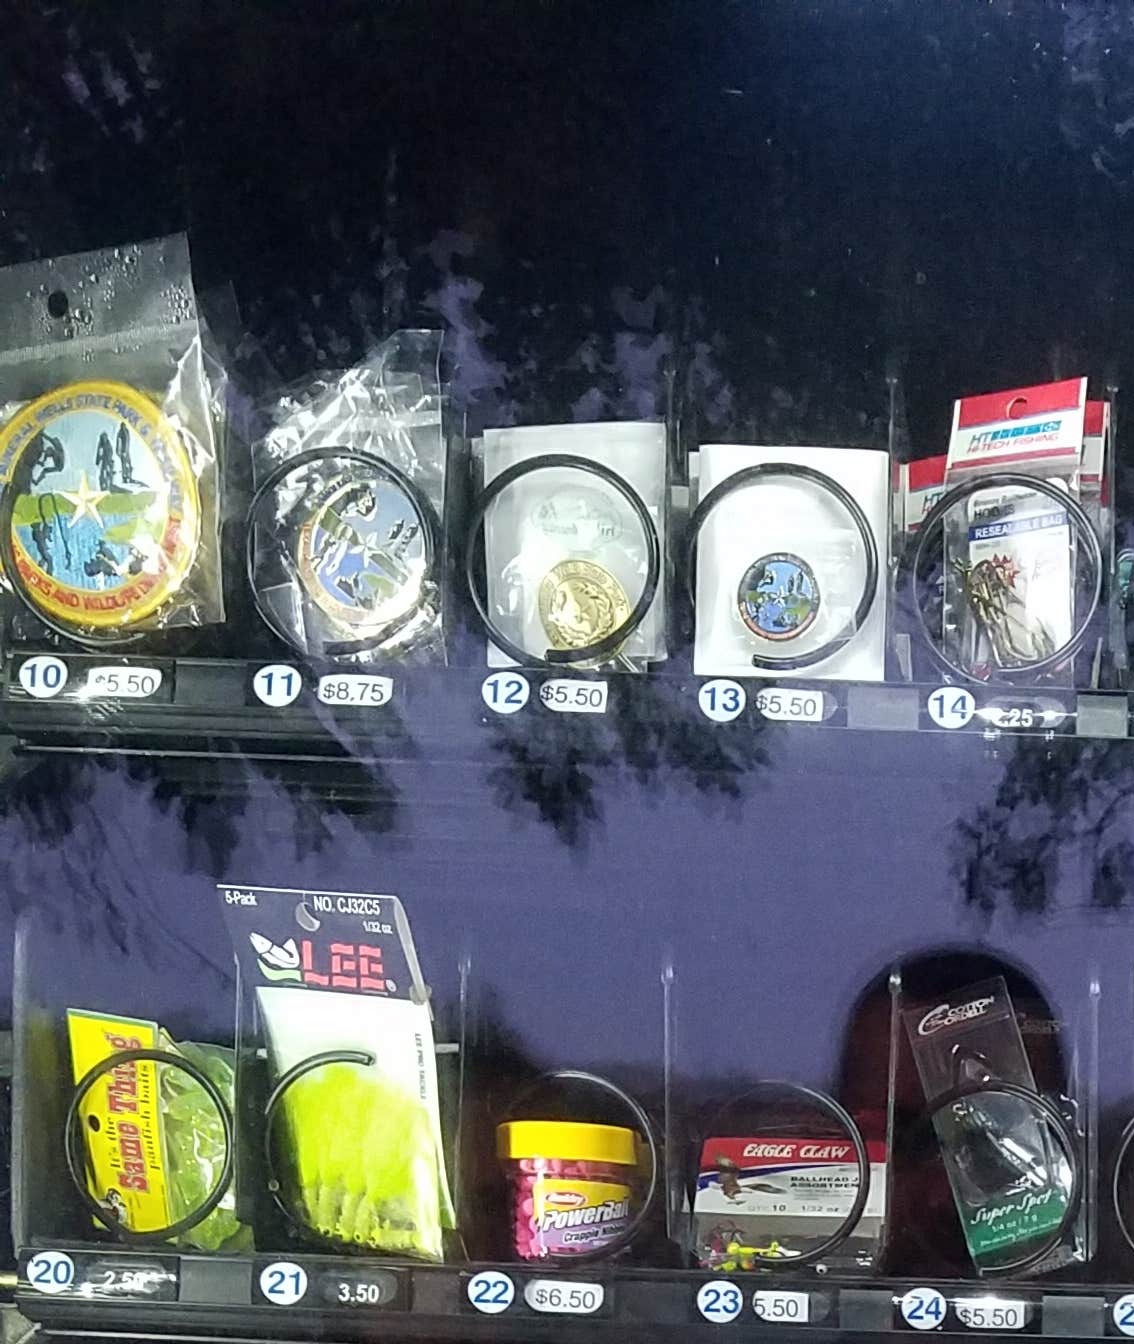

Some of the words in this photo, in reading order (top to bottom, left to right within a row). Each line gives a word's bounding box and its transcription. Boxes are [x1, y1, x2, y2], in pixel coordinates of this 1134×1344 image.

[25, 664, 61, 688] 10
[260, 673, 293, 696] 11
[323, 680, 384, 702] $8.75
[487, 680, 523, 704] 12
[541, 685, 602, 707] $5.50
[705, 688, 740, 712] 13
[756, 695, 816, 716] $5.50
[933, 696, 968, 720] 14
[225, 891, 257, 906] 5-Pack
[314, 897, 335, 912] NO.
[337, 900, 380, 915] CJ32C5
[302, 940, 384, 990] LEE
[118, 1121, 149, 1192] Same
[743, 1143, 798, 1158] EAGLE
[799, 1145, 850, 1159] CLAW
[970, 1204, 1015, 1226] Super
[33, 1260, 71, 1284] 20
[268, 1271, 301, 1294] 21
[339, 1285, 379, 1302] 3.50
[474, 1281, 509, 1304] 22
[535, 1288, 595, 1309] $6.50
[703, 1290, 739, 1313] 23
[906, 1296, 943, 1319] 24
[960, 1308, 1018, 1328] $5.50
